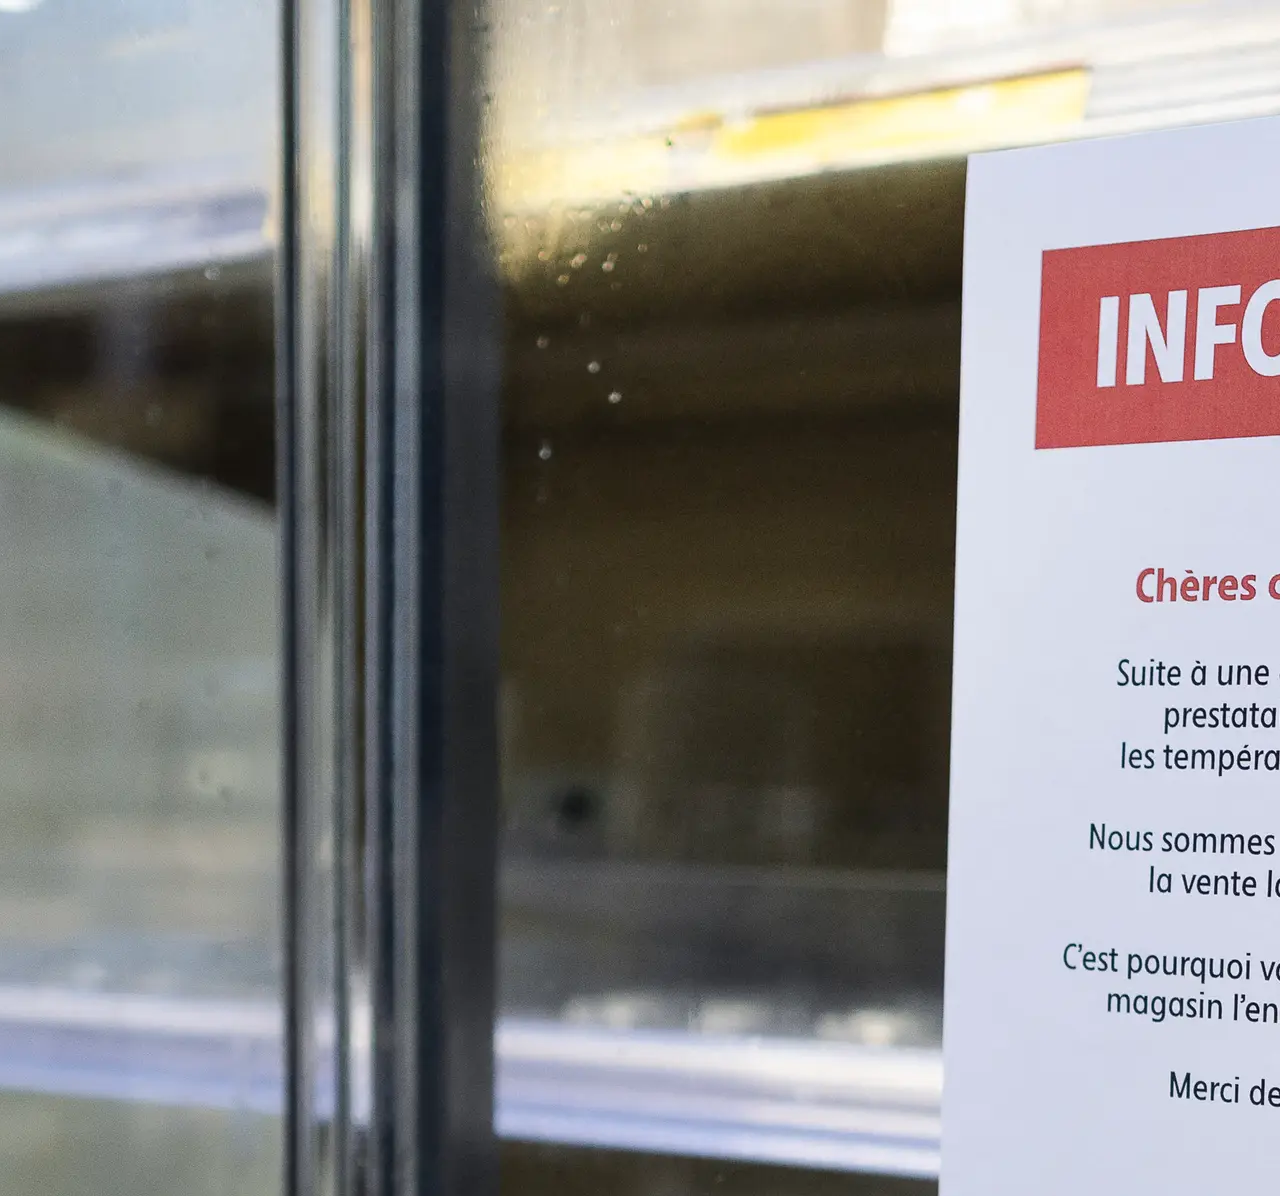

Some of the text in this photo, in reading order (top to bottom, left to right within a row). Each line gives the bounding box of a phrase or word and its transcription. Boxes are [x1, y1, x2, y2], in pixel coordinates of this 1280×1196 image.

[1135, 567, 1257, 604] Chères
[1116, 658, 1182, 687] Suite
[1190, 659, 1207, 687] à
[1217, 664, 1270, 687] une
[1120, 741, 1156, 770] les
[1089, 822, 1154, 852] Nous
[1161, 831, 1276, 856] sommes
[1149, 865, 1173, 894] la
[1180, 870, 1257, 898] vente
[1062, 942, 1119, 973] C’est
[1127, 952, 1252, 985] pourquoi
[1107, 991, 1223, 1023] magasin
[1169, 1070, 1240, 1104] Merci
